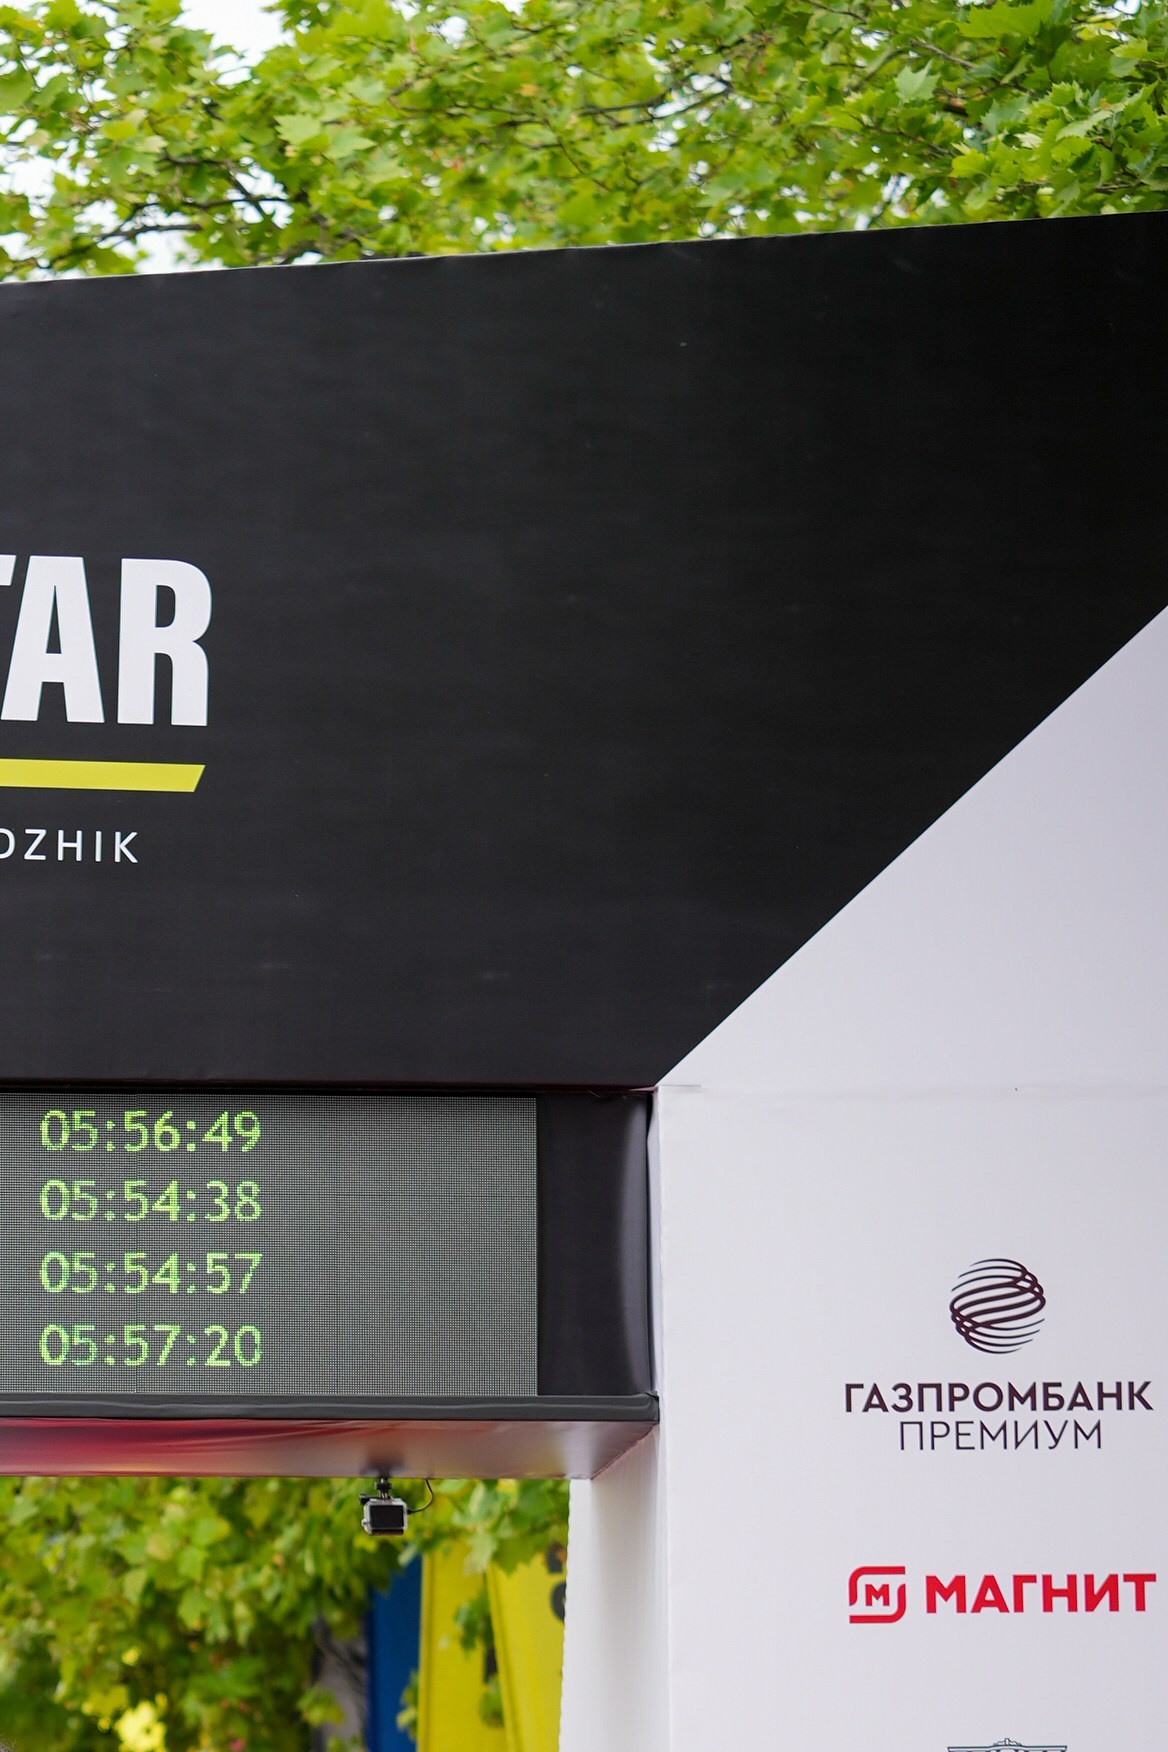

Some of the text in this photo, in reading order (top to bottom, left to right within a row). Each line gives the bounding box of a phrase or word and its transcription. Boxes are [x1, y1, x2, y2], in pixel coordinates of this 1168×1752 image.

[39, 1109, 262, 1153] 05:56:49
[39, 1179, 262, 1221] 05:54:38
[39, 1250, 262, 1294] 05:54:57
[39, 1323, 262, 1367] 05:57:20
[844, 1380, 1154, 1413] ГАЗПРОМБАНК
[899, 1419, 1102, 1451] ПРЕМИУМ
[925, 1572, 1157, 1614] МАГНИТ
